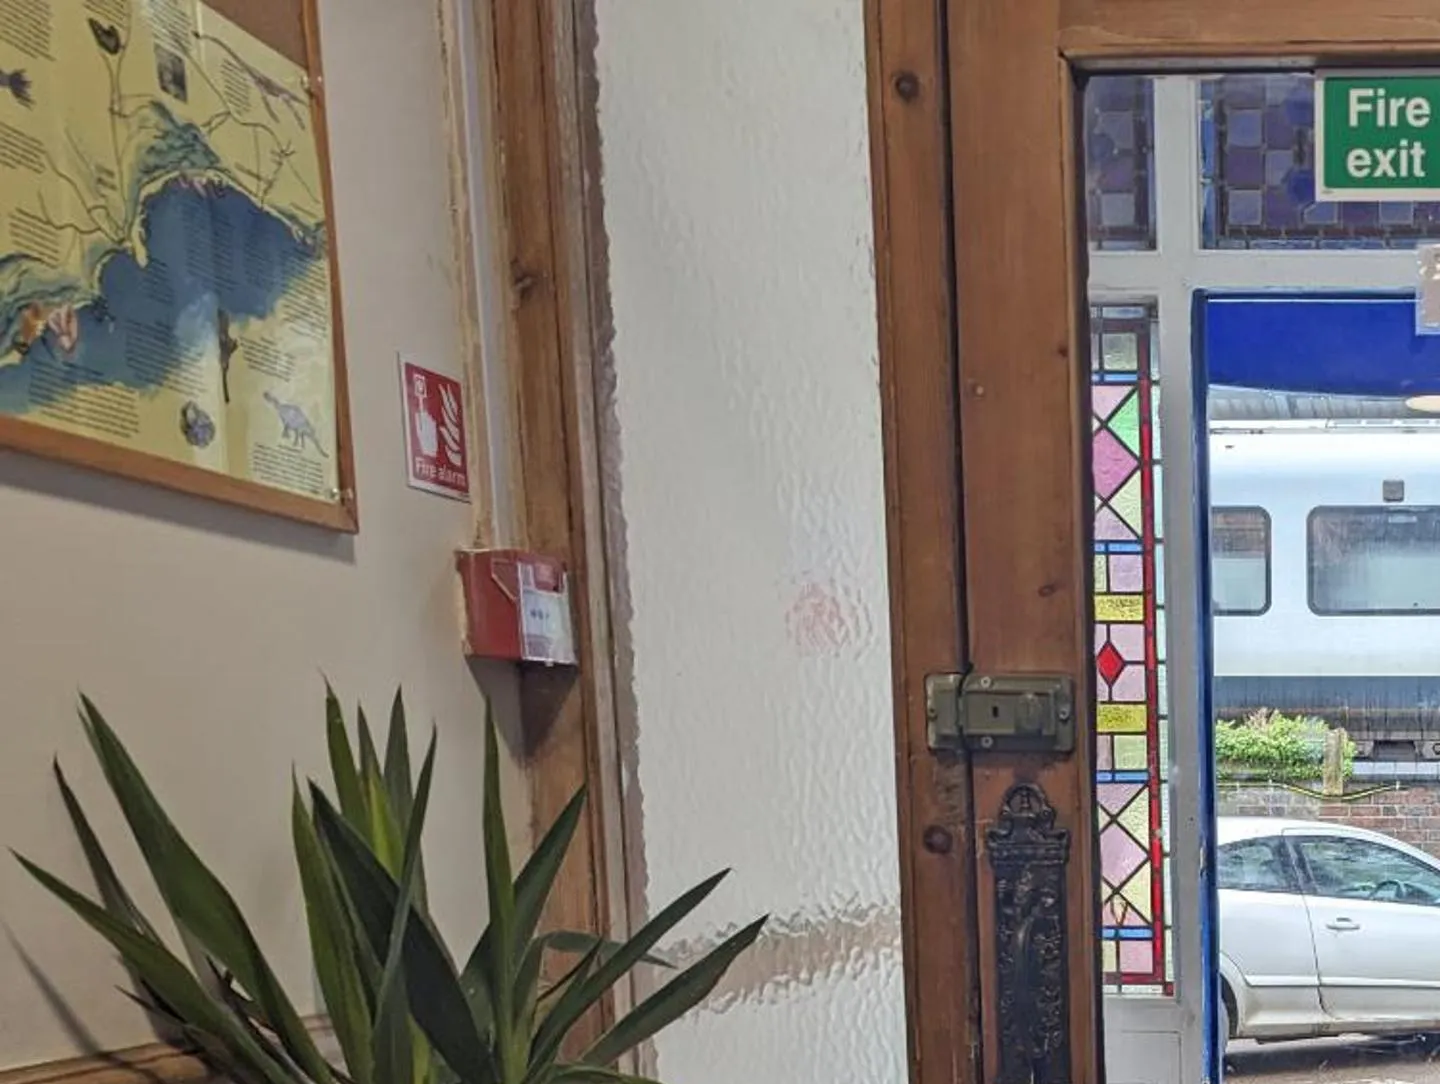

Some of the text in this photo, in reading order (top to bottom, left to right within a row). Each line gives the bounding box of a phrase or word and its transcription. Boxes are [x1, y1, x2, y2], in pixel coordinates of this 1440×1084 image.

[1348, 87, 1431, 128] Fire
[1345, 139, 1427, 179] exit
[414, 456, 467, 487] Fire alarm
